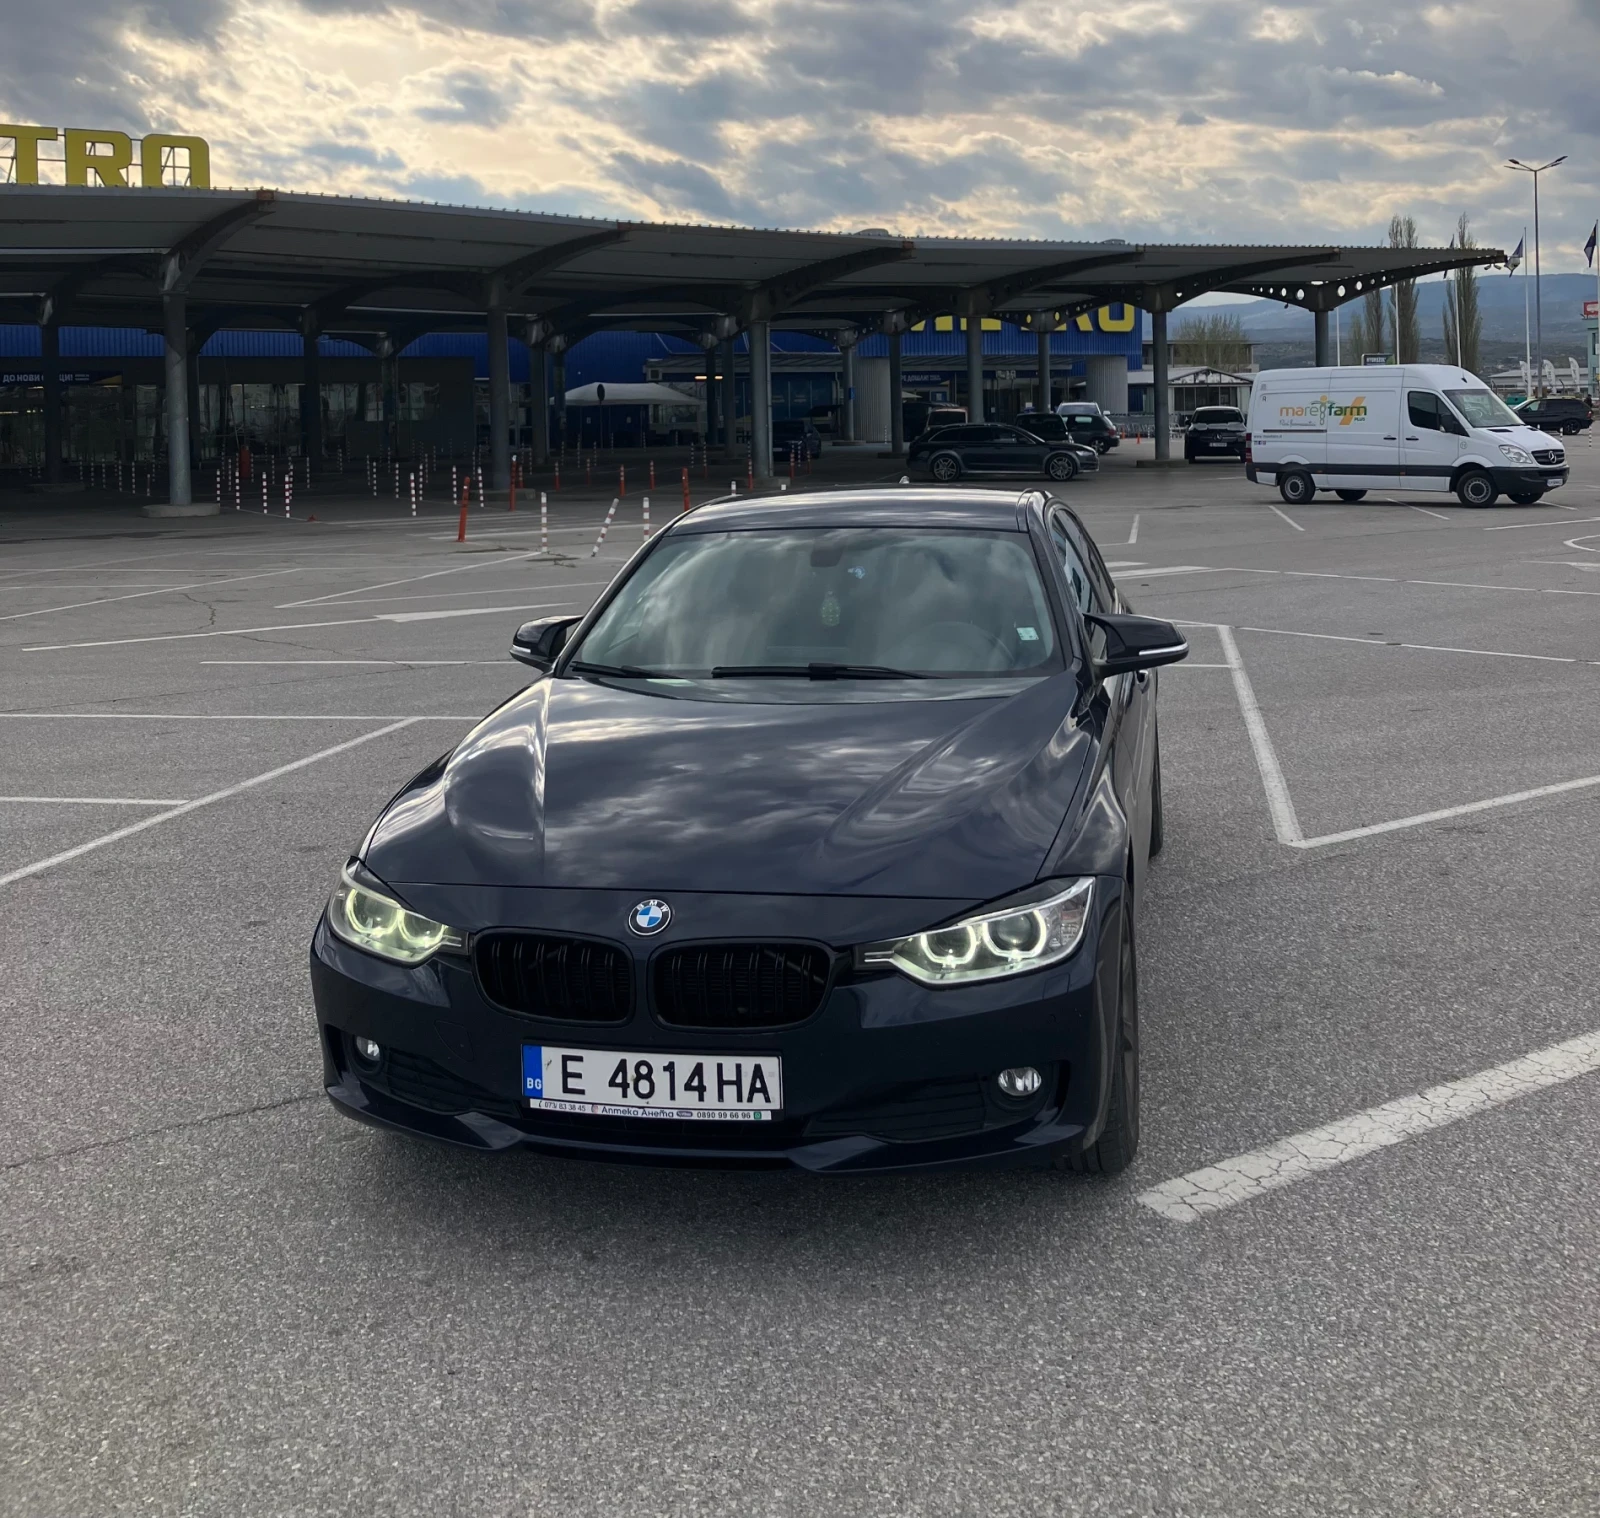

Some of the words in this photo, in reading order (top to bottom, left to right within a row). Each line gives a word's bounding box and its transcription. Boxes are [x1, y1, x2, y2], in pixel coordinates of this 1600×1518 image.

[2, 374, 16, 383] ДО
[16, 374, 41, 382] НОВИ
[561, 1054, 586, 1096] E
[526, 1077, 542, 1090] BG
[696, 1110, 716, 1119] 0890
[718, 1111, 727, 1119] 99
